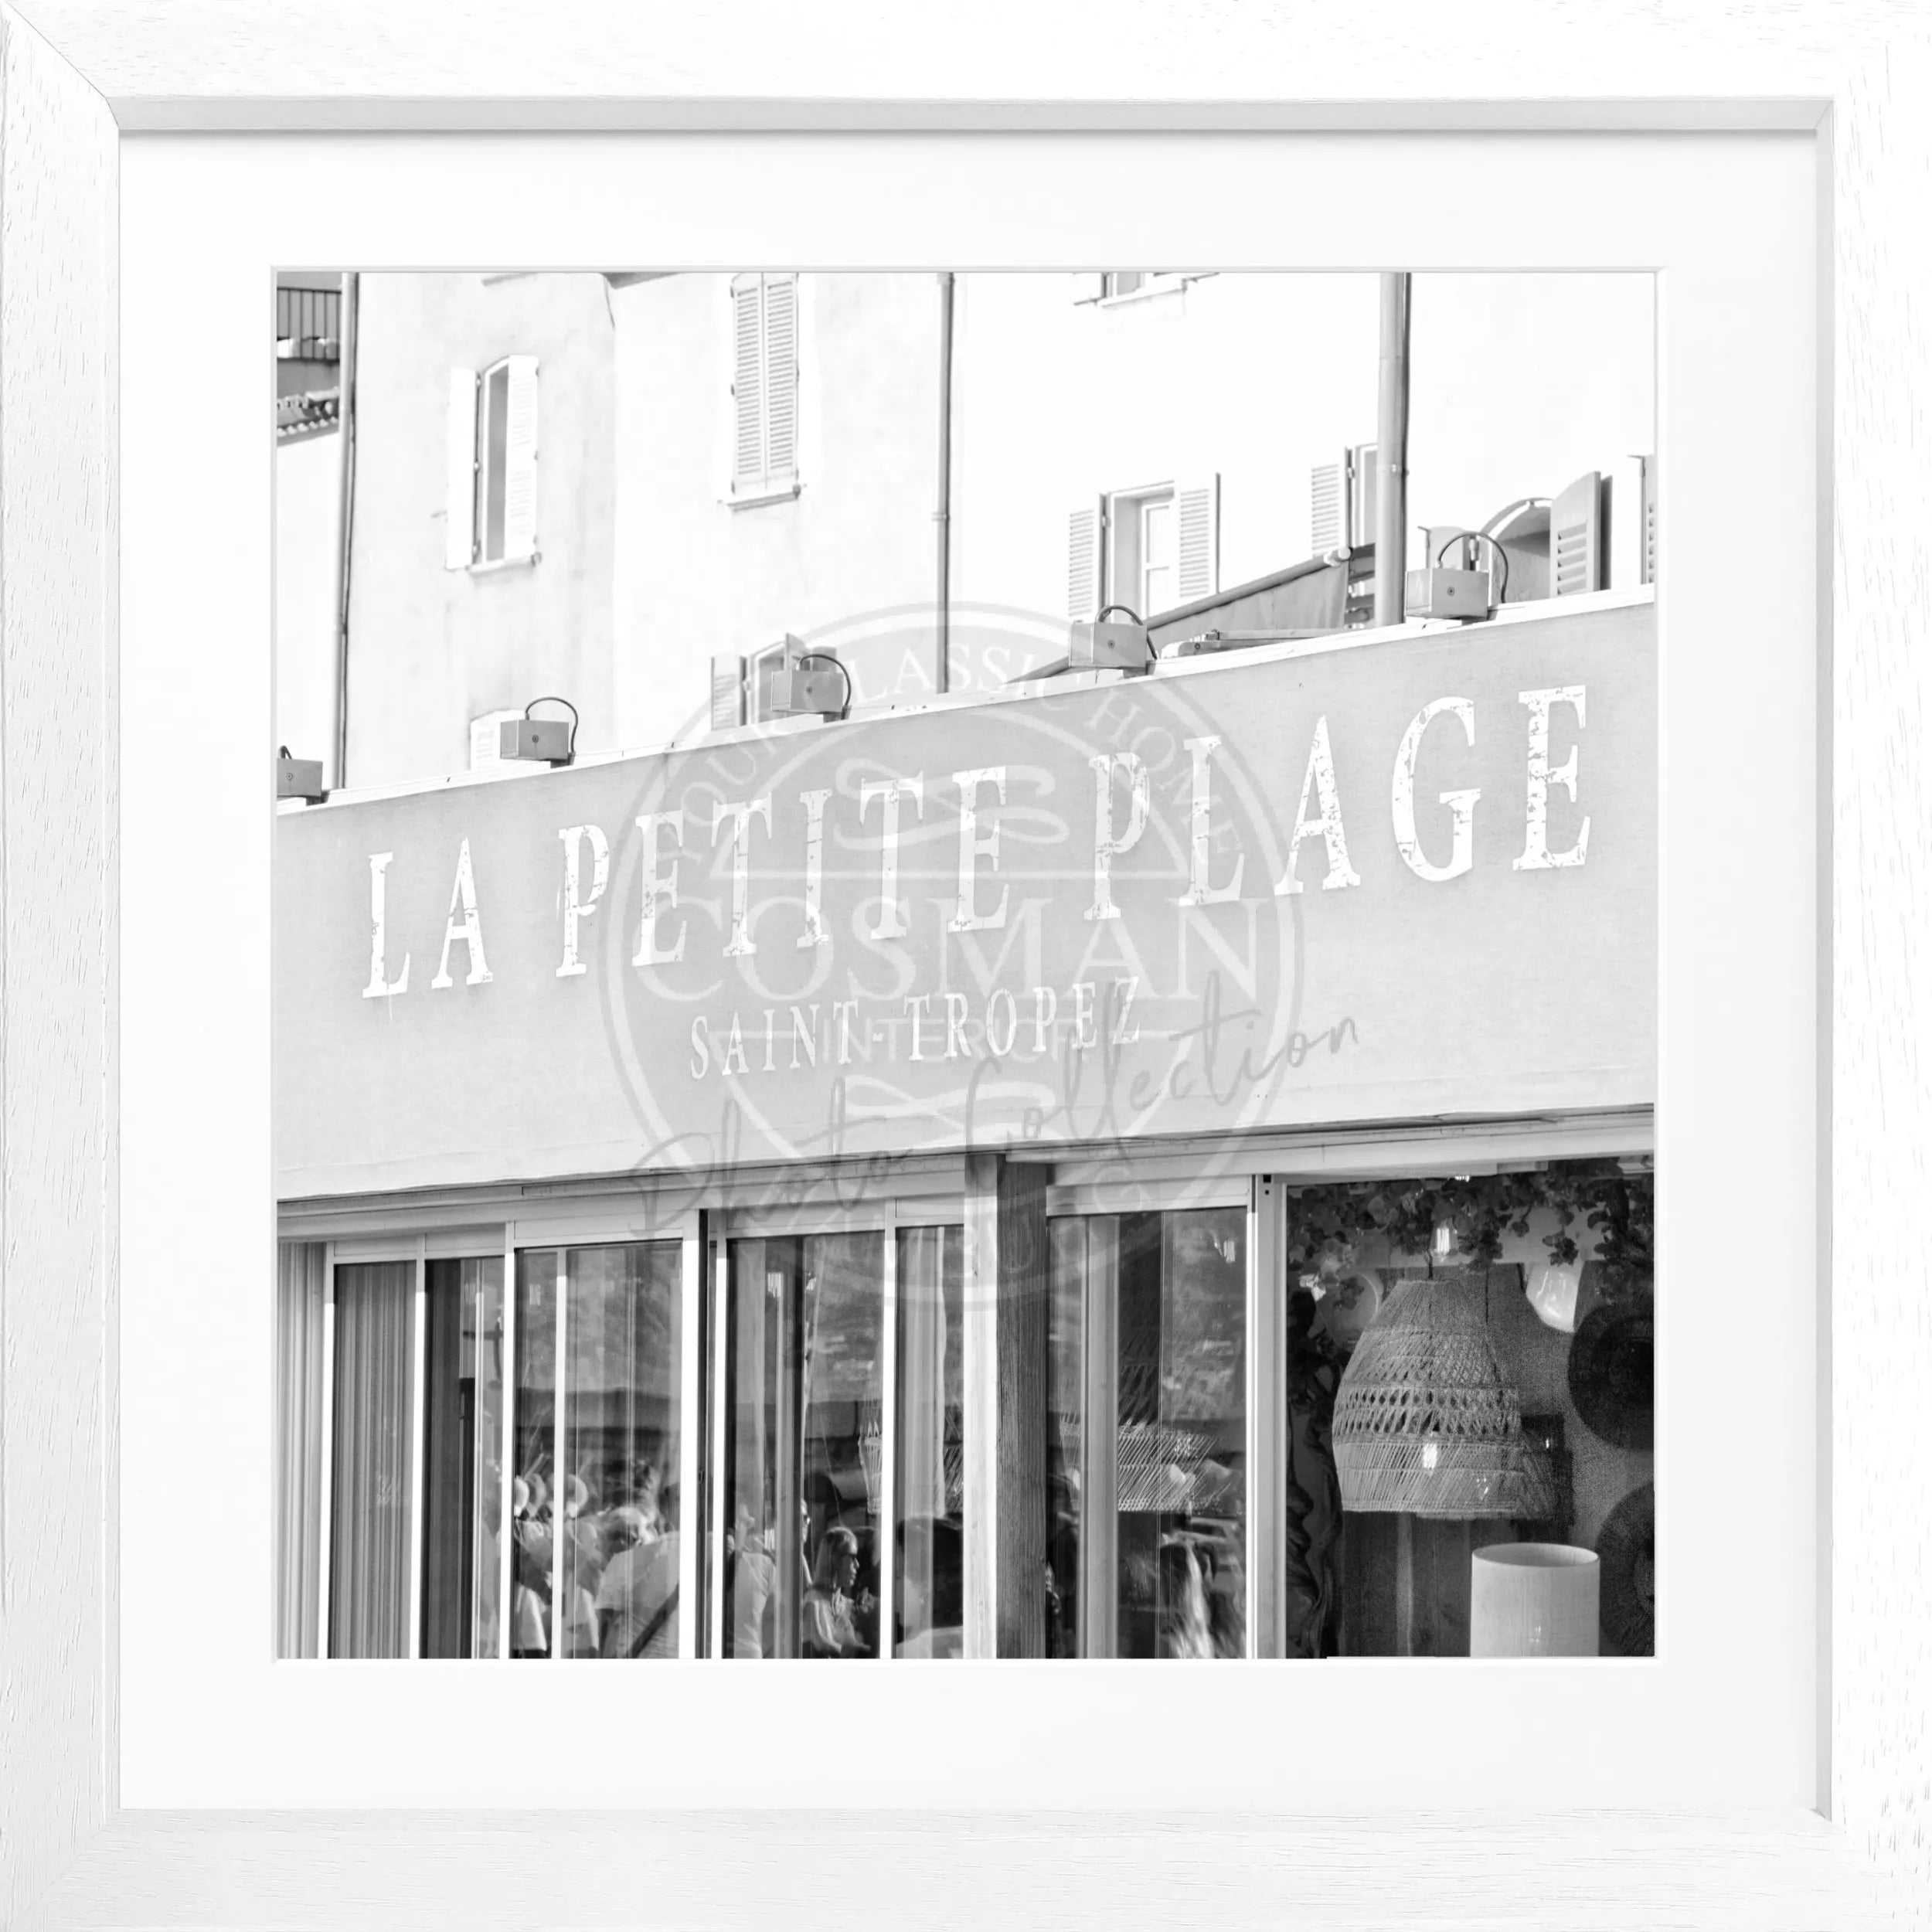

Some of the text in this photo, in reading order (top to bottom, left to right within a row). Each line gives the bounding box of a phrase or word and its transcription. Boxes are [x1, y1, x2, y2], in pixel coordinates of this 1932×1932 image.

[362, 684, 1591, 999] LA PETITE PLAGE
